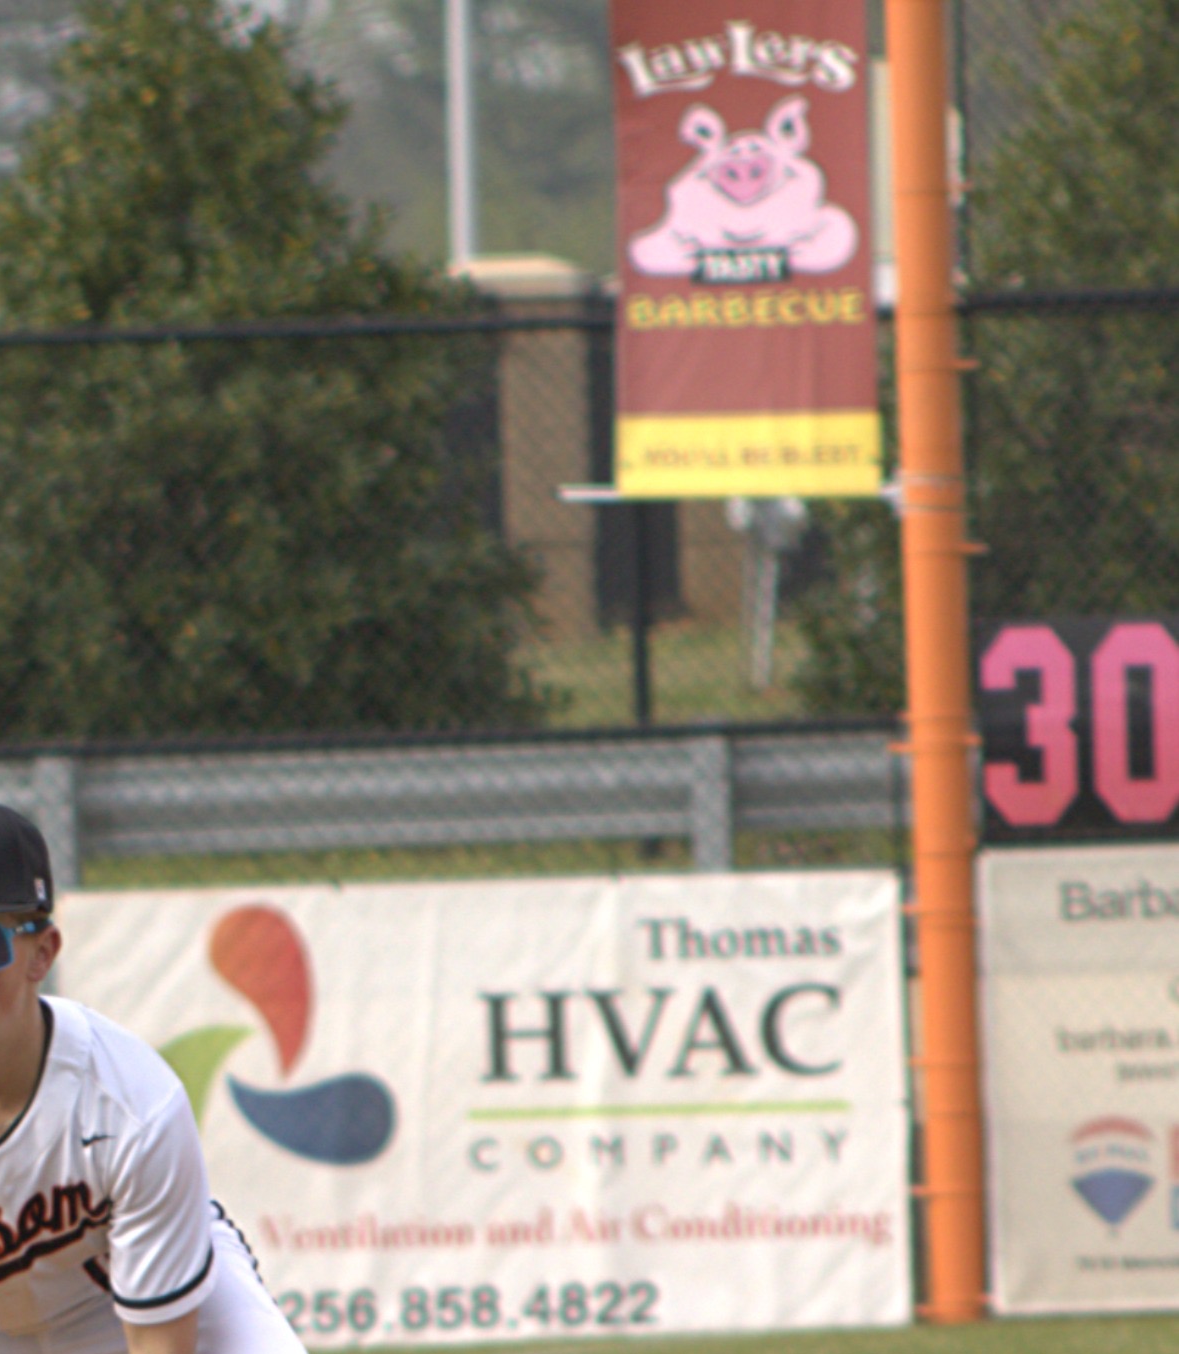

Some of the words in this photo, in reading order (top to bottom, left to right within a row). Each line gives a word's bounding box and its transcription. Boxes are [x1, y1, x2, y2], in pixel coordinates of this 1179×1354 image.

[626, 287, 864, 328] BARBECUE
[639, 918, 842, 960] Thomas
[478, 981, 842, 1082] HVAC
[468, 1129, 848, 1172] COMPANY
[259, 1212, 474, 1249] Ventilation
[487, 1206, 554, 1244] and
[568, 1205, 622, 1241] Air
[630, 1201, 893, 1248] Conditioning
[277, 1280, 658, 1333] 256.858.4822
